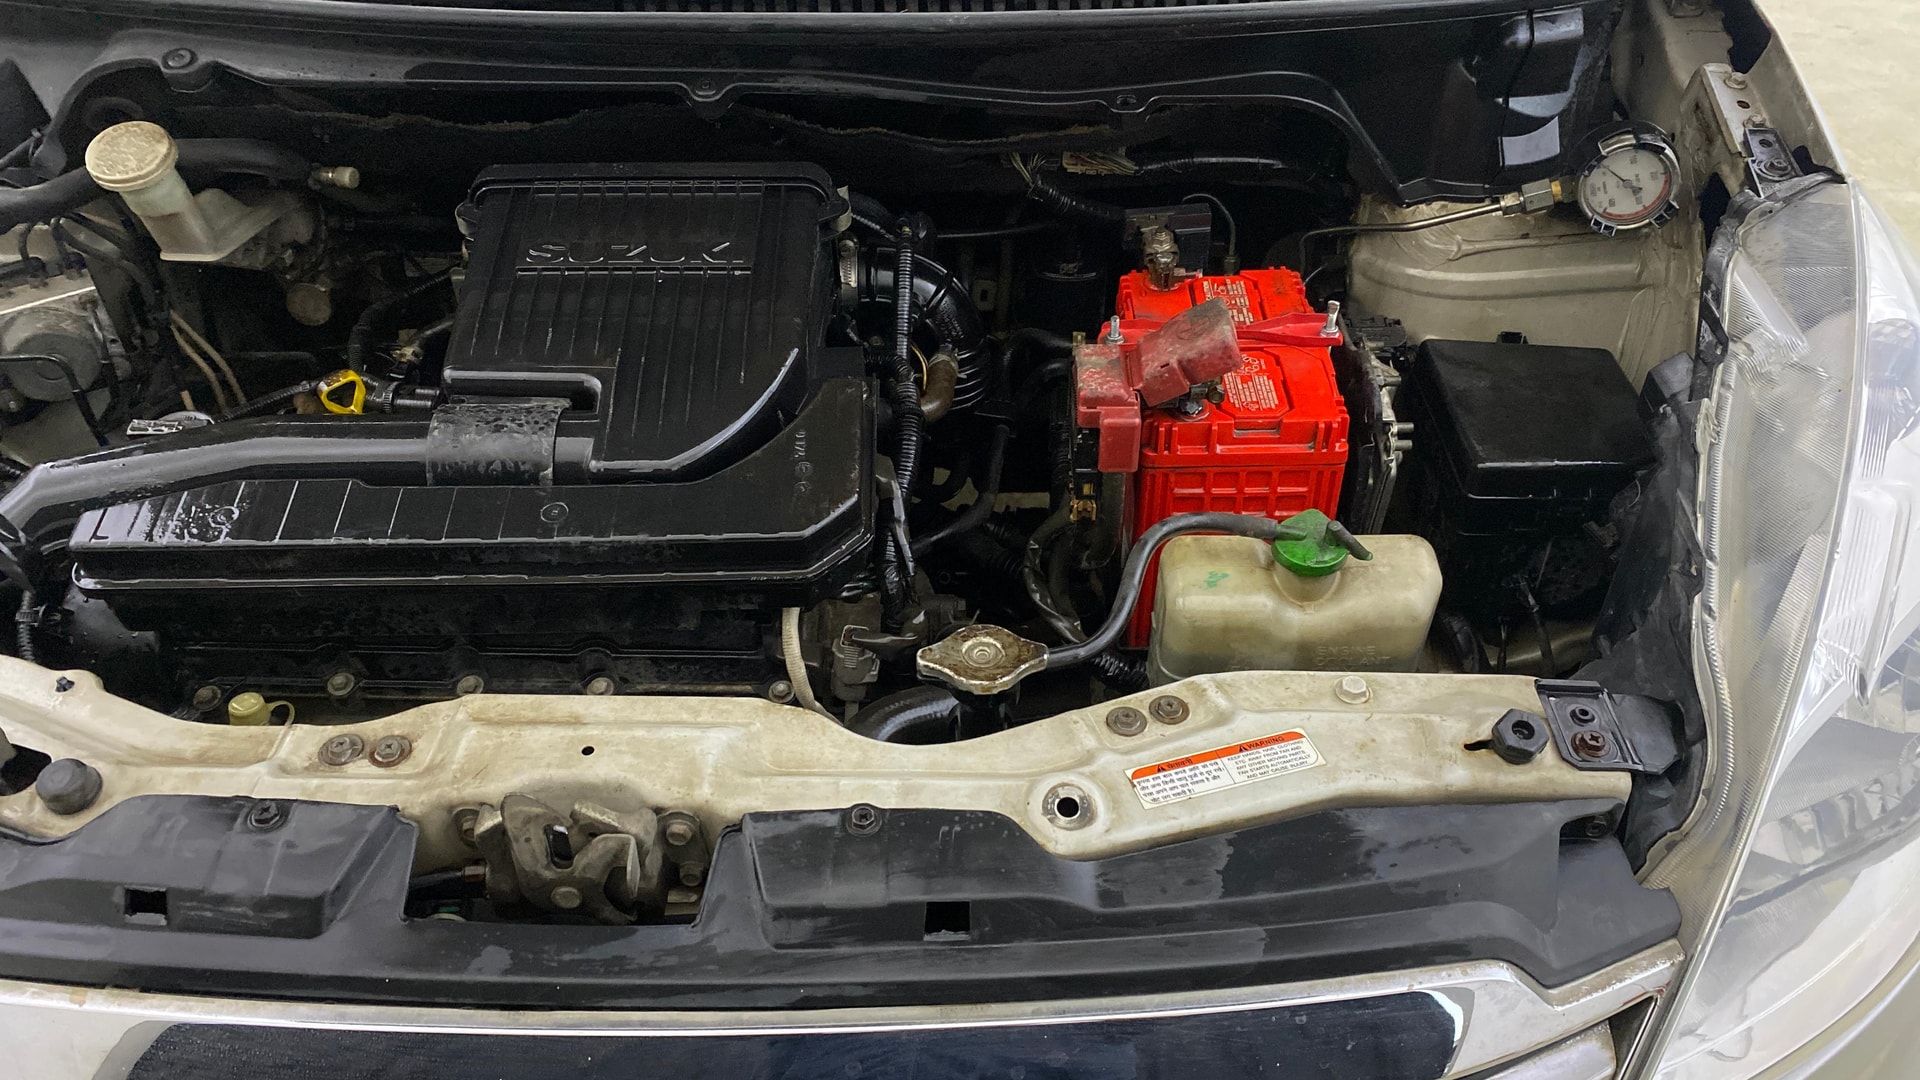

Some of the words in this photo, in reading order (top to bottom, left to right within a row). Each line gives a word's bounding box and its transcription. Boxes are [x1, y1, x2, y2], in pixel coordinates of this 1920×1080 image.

[1318, 645, 1376, 656] ENGINE
[1247, 736, 1285, 749] WARNING
[1277, 740, 1303, 748] CLOTHING
[1270, 755, 1311, 767] AUTOMATICALLY
